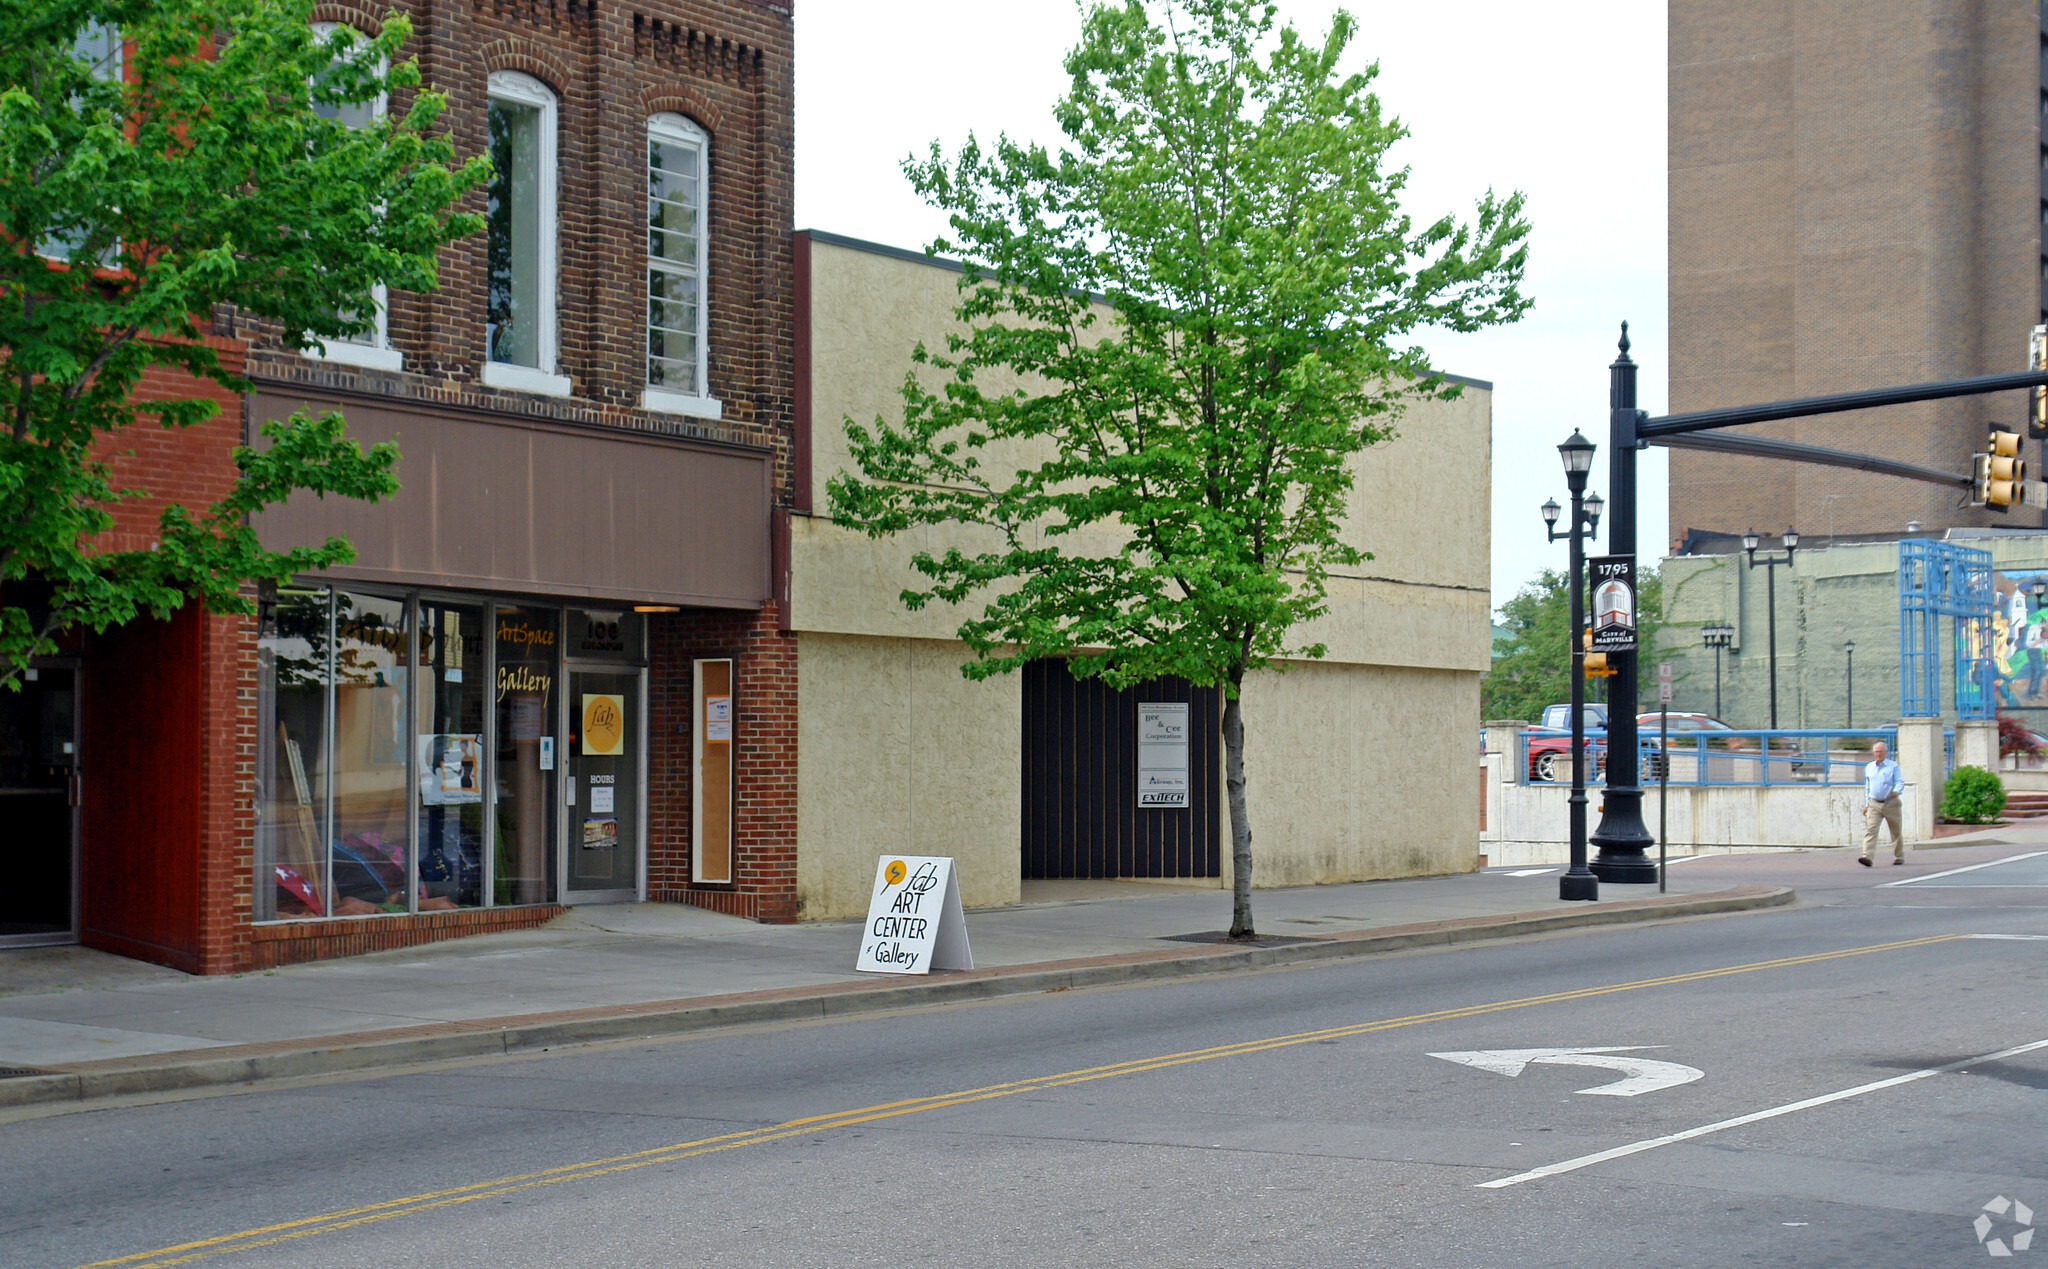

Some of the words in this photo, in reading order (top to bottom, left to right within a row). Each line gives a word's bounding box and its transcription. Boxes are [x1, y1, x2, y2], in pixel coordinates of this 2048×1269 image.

[1598, 563, 1628, 576] 1795
[497, 620, 554, 656] ArtSpace
[1595, 635, 1634, 643] MARYVILLE
[497, 666, 551, 708] Gallery
[587, 705, 613, 732] fab
[1145, 714, 1160, 722] Bee
[1165, 725, 1182, 733] Cee
[590, 774, 615, 784] HOURS
[902, 862, 938, 892] fab
[890, 892, 925, 914] ART
[873, 917, 928, 940] CENTER
[875, 941, 920, 970] Gallery
